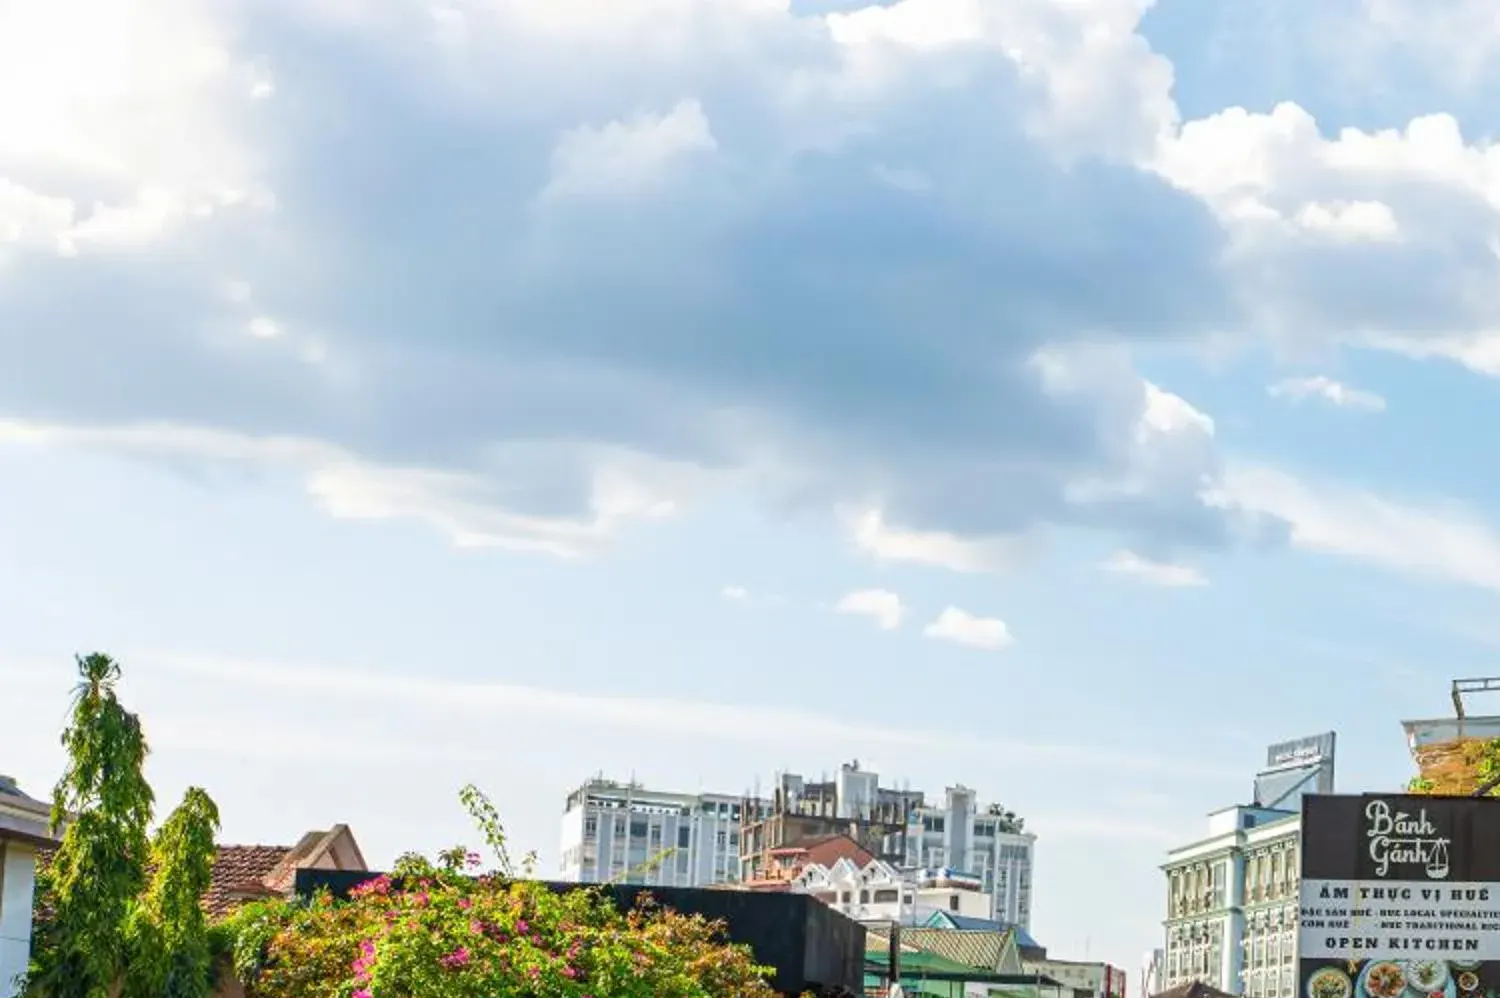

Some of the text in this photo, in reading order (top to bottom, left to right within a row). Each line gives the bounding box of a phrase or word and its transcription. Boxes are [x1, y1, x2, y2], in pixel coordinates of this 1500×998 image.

[1365, 799, 1438, 837] Bánh
[1369, 836, 1432, 877] Gánh
[1403, 908, 1437, 919] LOCAL
[1405, 921, 1477, 931] TRADITIONAL
[1325, 937, 1479, 950] OPEN KITCHEN
